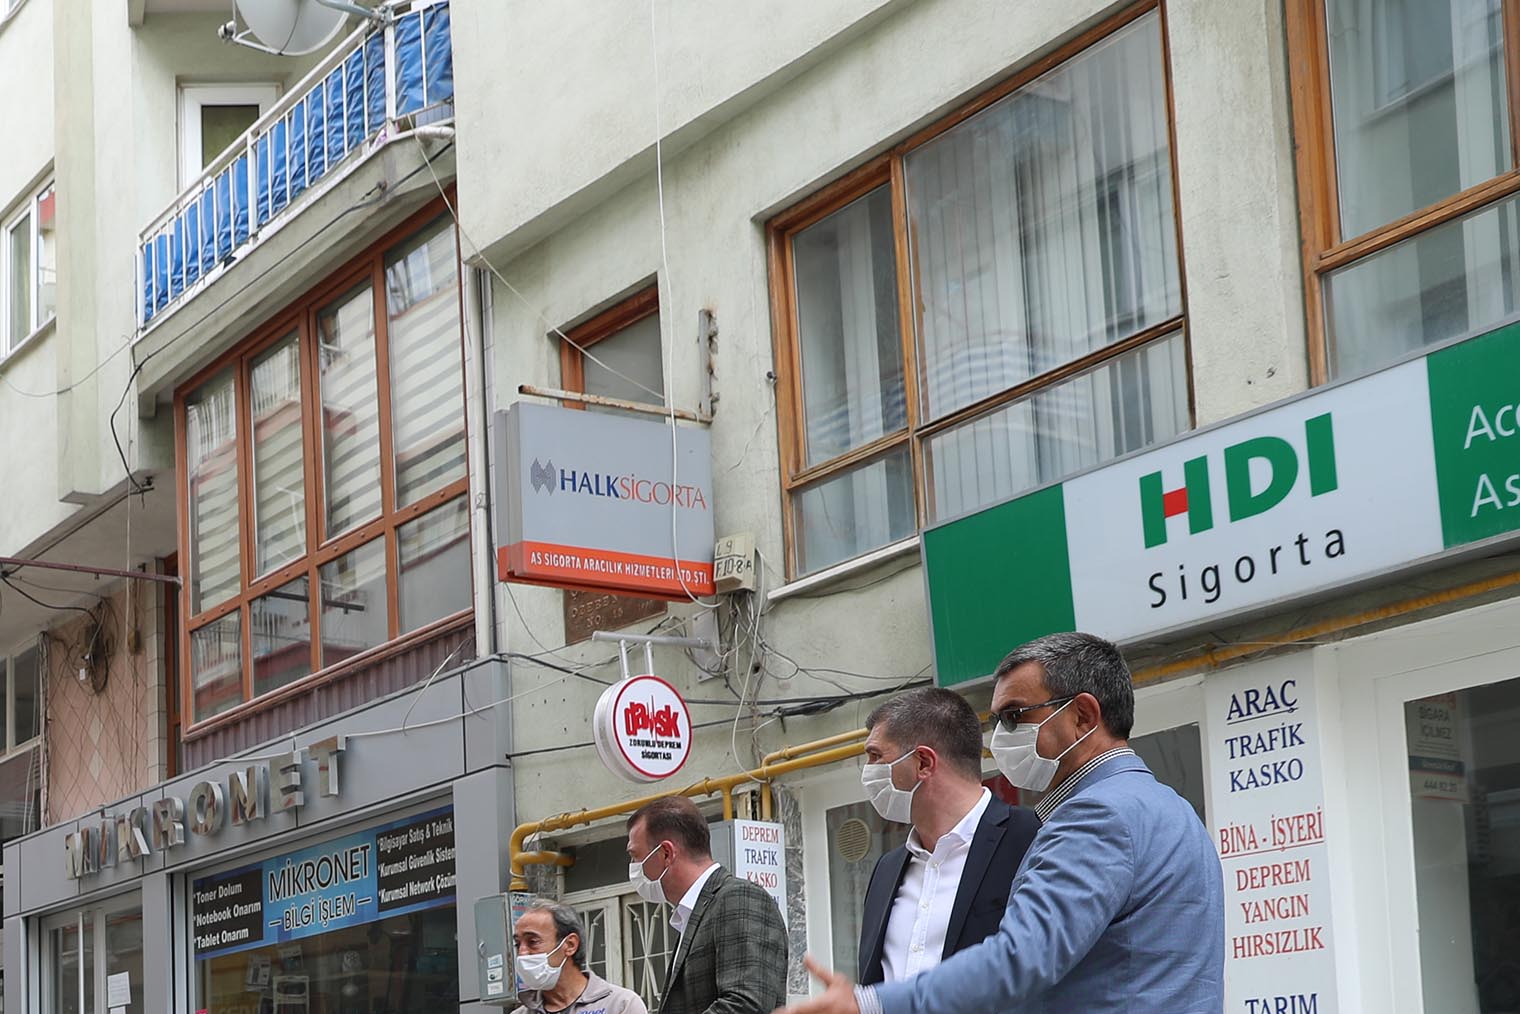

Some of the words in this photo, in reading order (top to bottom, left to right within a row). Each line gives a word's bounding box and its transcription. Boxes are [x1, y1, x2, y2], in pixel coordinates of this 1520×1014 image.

[1139, 411, 1339, 549] HDI
[530, 551, 542, 565] AS
[583, 557, 623, 575] ARACILIK
[1148, 528, 1346, 609] Sigorta
[1226, 679, 1298, 721] ARAÇ
[1224, 722, 1305, 760] TRAFİK
[1229, 757, 1304, 793] KASKO
[64, 735, 347, 880] MİKRONET
[425, 823, 431, 839] &
[742, 825, 779, 844] DEPREM
[1219, 821, 1259, 855] BİNA
[1271, 806, 1323, 852] İŞYERİ
[268, 842, 371, 904] MİKRONET
[744, 847, 778, 866] TRAFİK
[218, 883, 243, 899] Dolum
[1235, 858, 1311, 892] DEPREM
[233, 901, 261, 918] Onarım
[283, 902, 316, 931] BİLGİ
[318, 891, 355, 928] İŞLEM
[1240, 893, 1310, 924] YANGIN
[221, 927, 249, 943] Onarım
[1232, 926, 1325, 959] HIRSIZLIK
